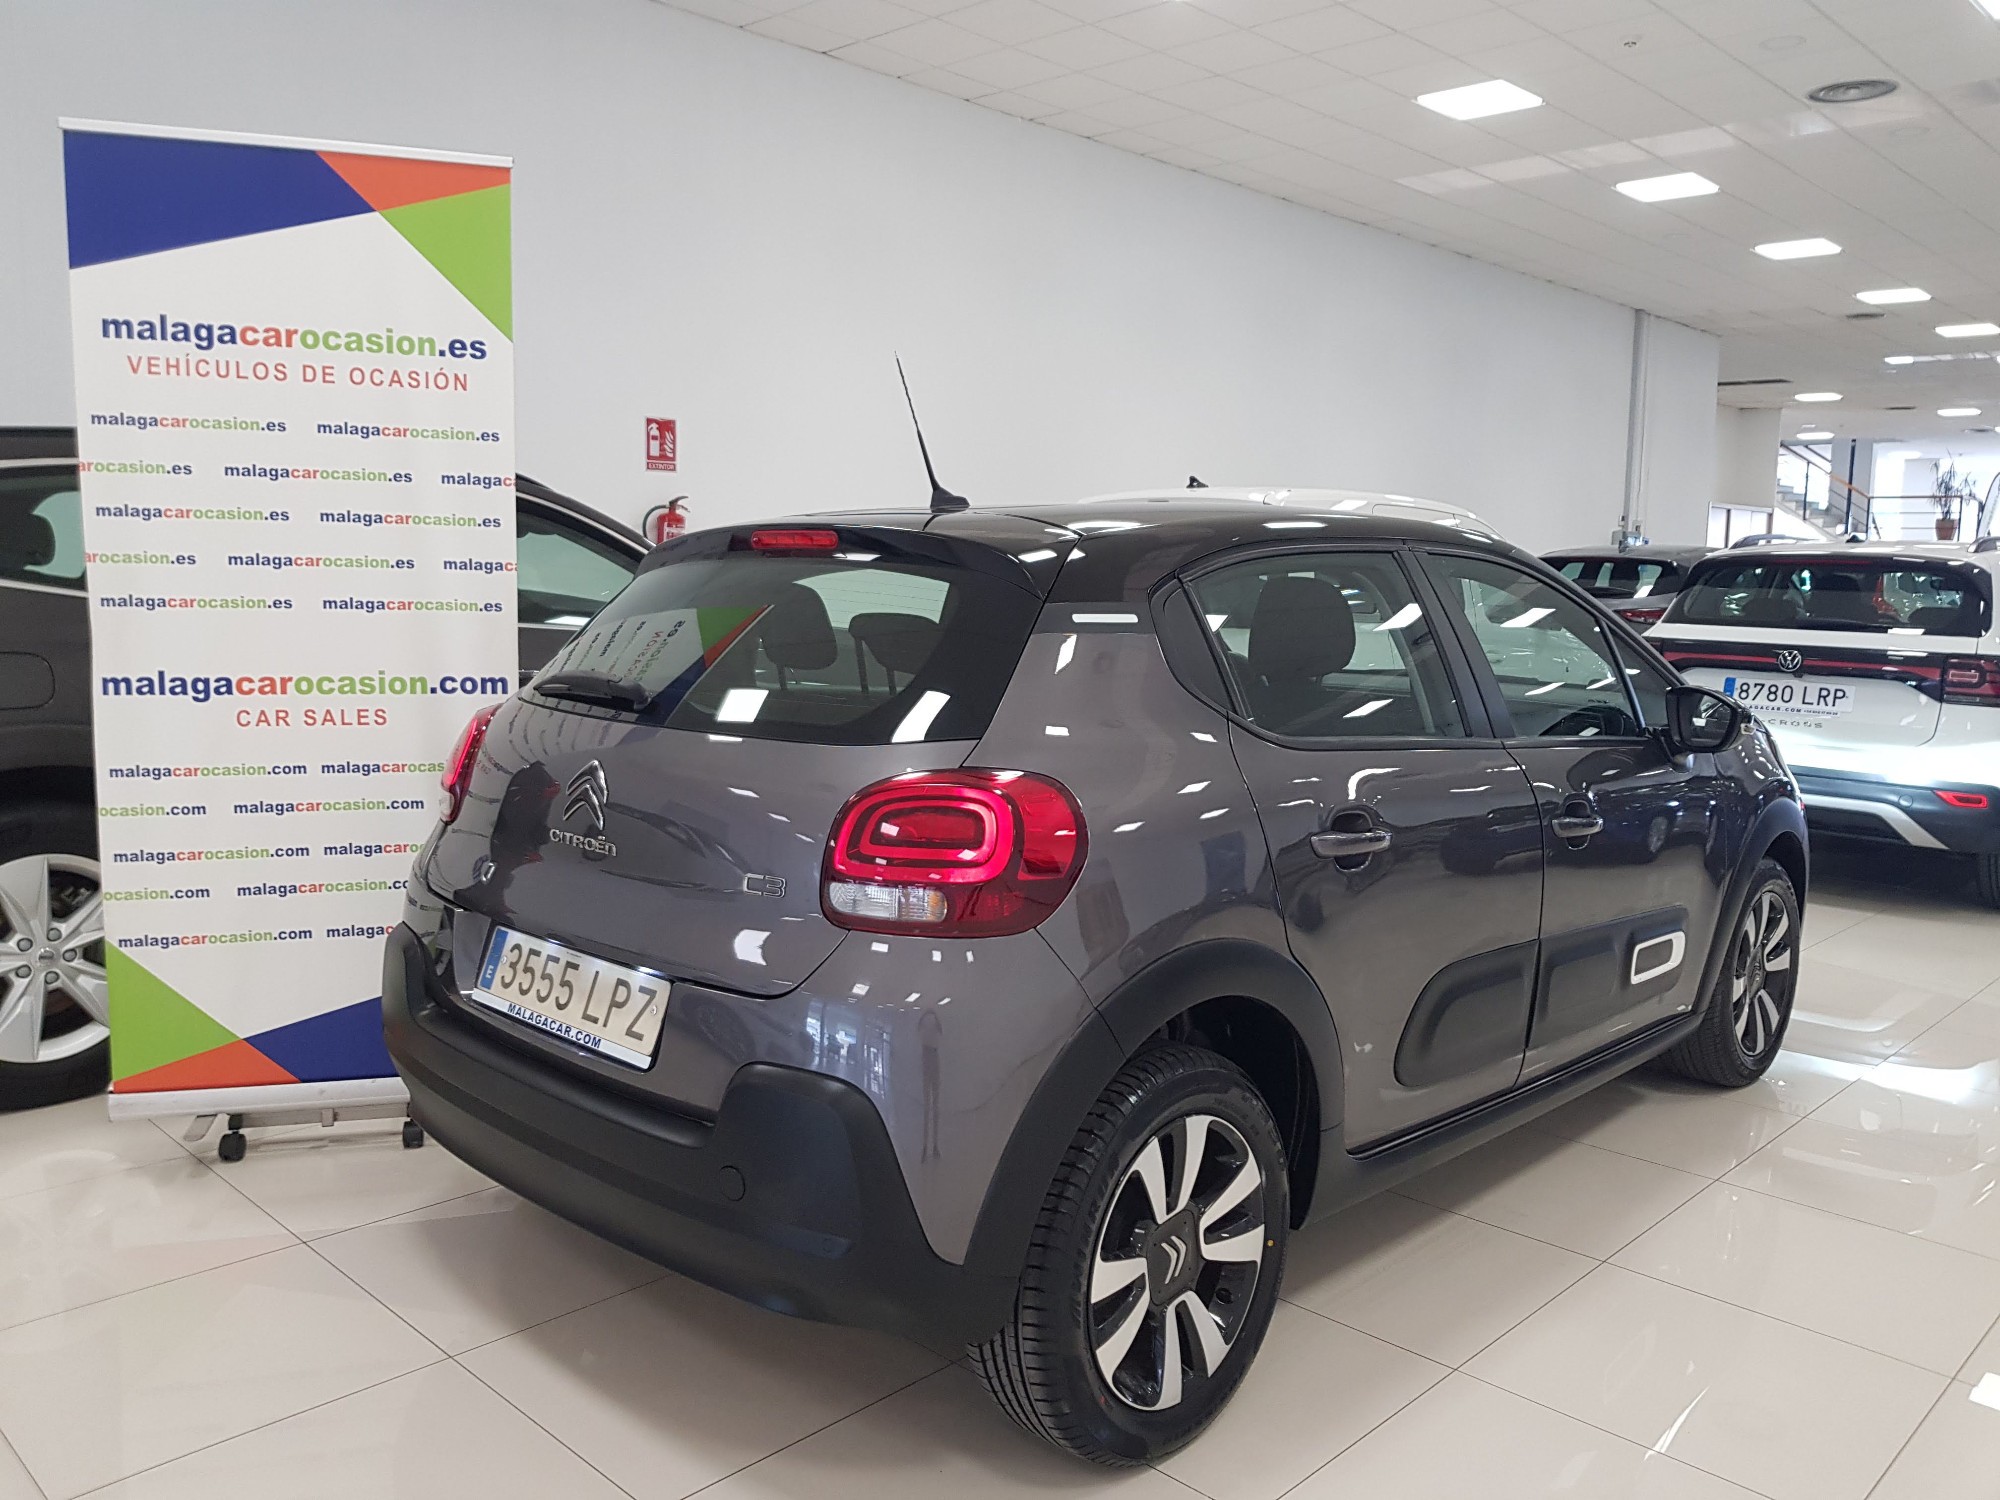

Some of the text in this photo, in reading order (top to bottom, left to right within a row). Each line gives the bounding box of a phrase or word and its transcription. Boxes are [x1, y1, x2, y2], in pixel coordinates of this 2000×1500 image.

[101, 314, 488, 361] malagacarocasion.es
[126, 352, 468, 392] VEHÍCULOS DE OCASIÓN
[90, 411, 287, 433] malagacarocasion.es
[316, 421, 500, 443] malagacarocasion.es
[224, 463, 413, 484] malagacarocasion.es
[95, 503, 290, 523] malagacarocasion.es
[319, 509, 502, 528] malagacarocasion.es
[227, 552, 415, 571] malagacarocasion.es
[100, 594, 293, 612] malagacarocasion.es
[322, 596, 503, 614] malagacarocasion.es
[101, 670, 509, 703] malagacarocasion.com
[1738, 682, 1847, 707] 8780 LRP
[236, 708, 388, 728] CAR SALES
[109, 763, 308, 781] malagacarocasion.com
[233, 797, 425, 816] malagacarocasion.com
[113, 846, 310, 865] malagacarocasion.com
[742, 873, 787, 898] C3
[118, 928, 313, 949] malagacarocasion.com
[485, 943, 658, 1042] E 3555 LPZ
[507, 1003, 602, 1049] MALAGACAR.COM
